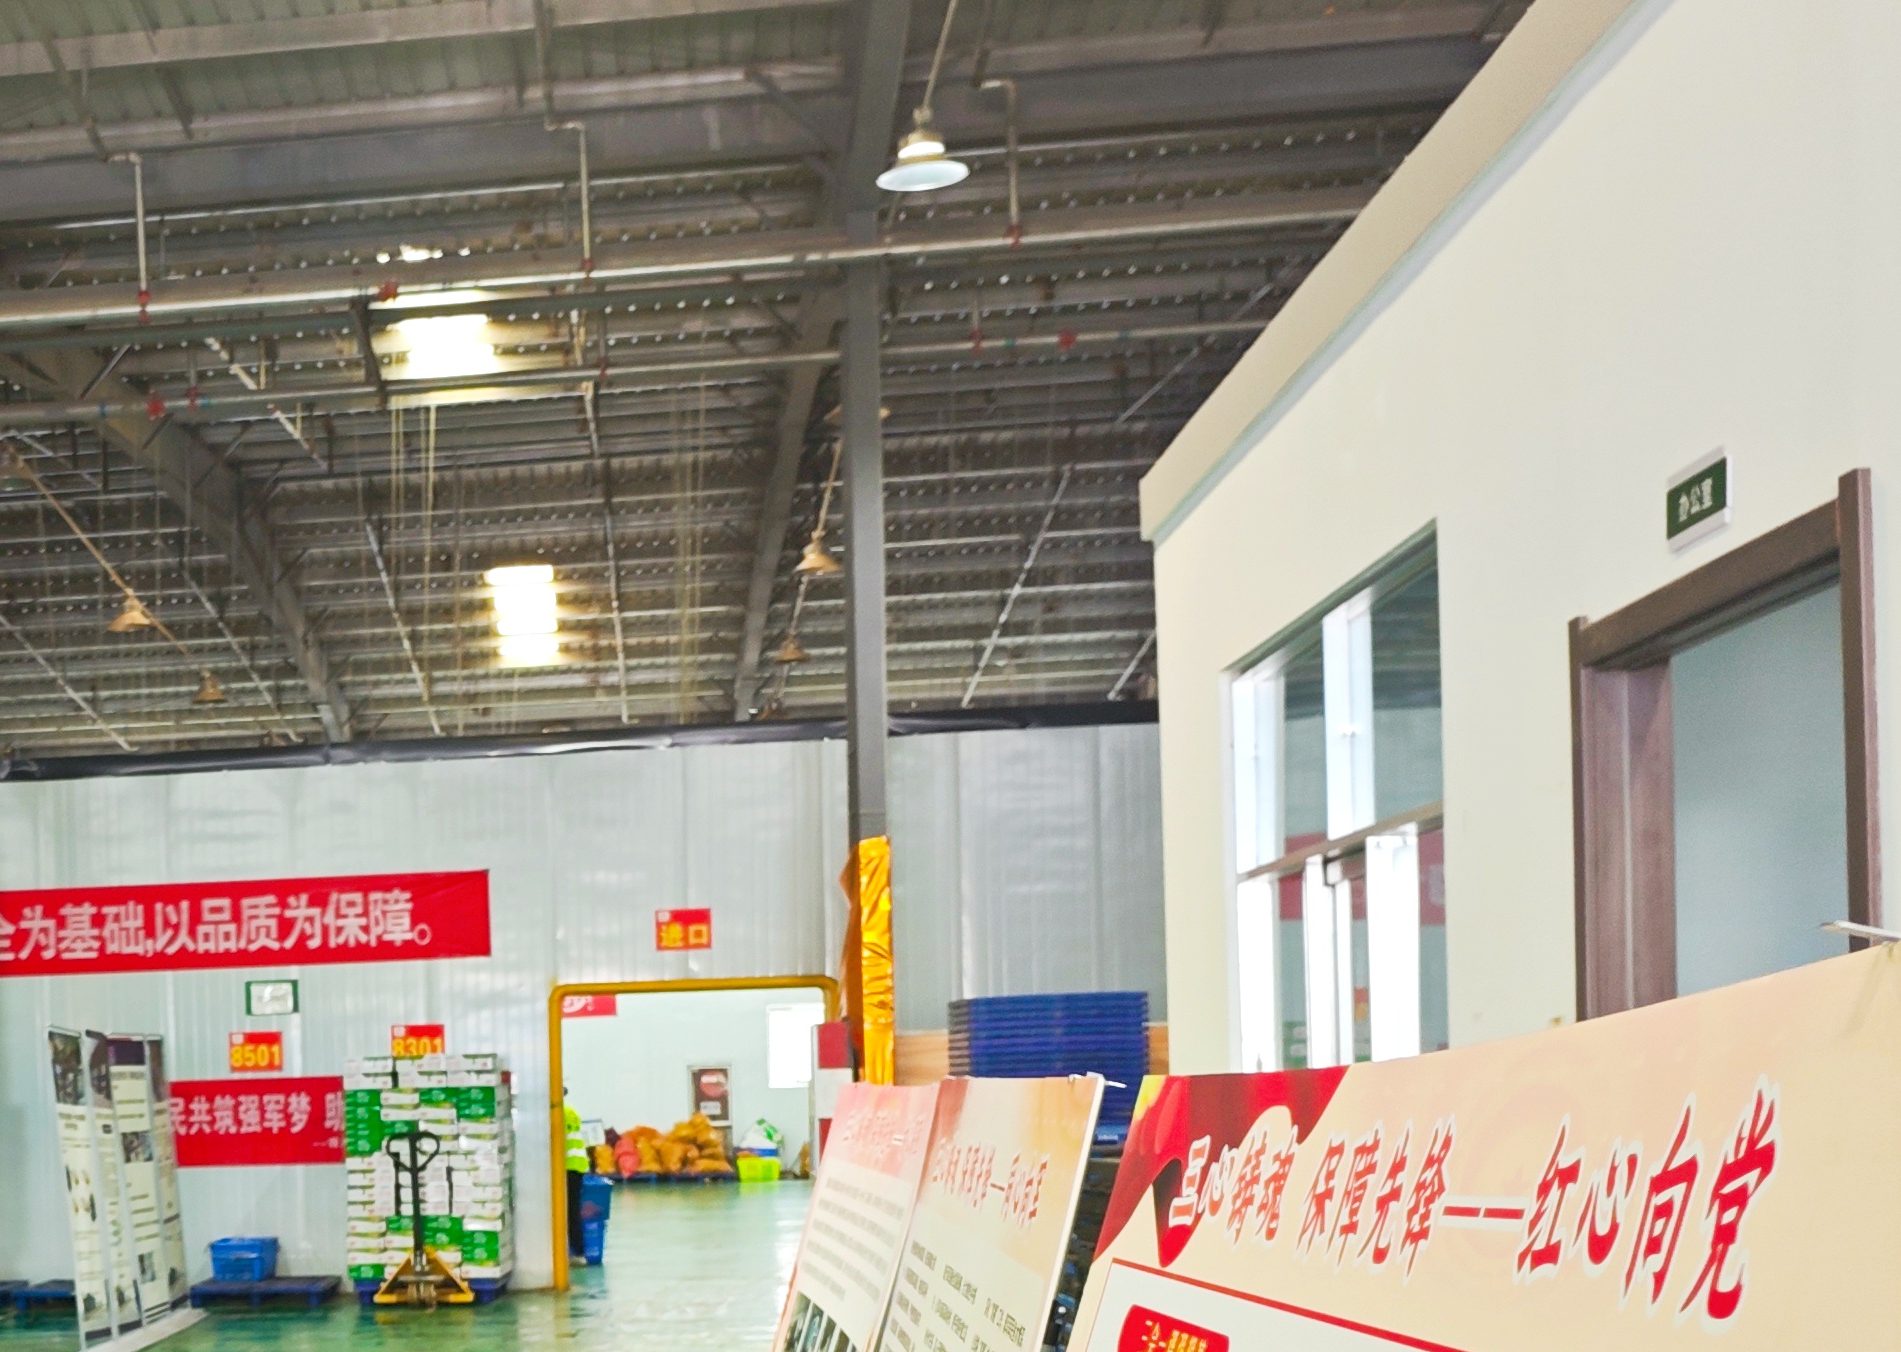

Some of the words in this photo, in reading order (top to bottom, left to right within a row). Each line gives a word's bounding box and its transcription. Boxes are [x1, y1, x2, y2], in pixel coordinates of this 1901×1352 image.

[230, 1044, 280, 1067] 8501
[1167, 1125, 1302, 1252] 三心铸魂
